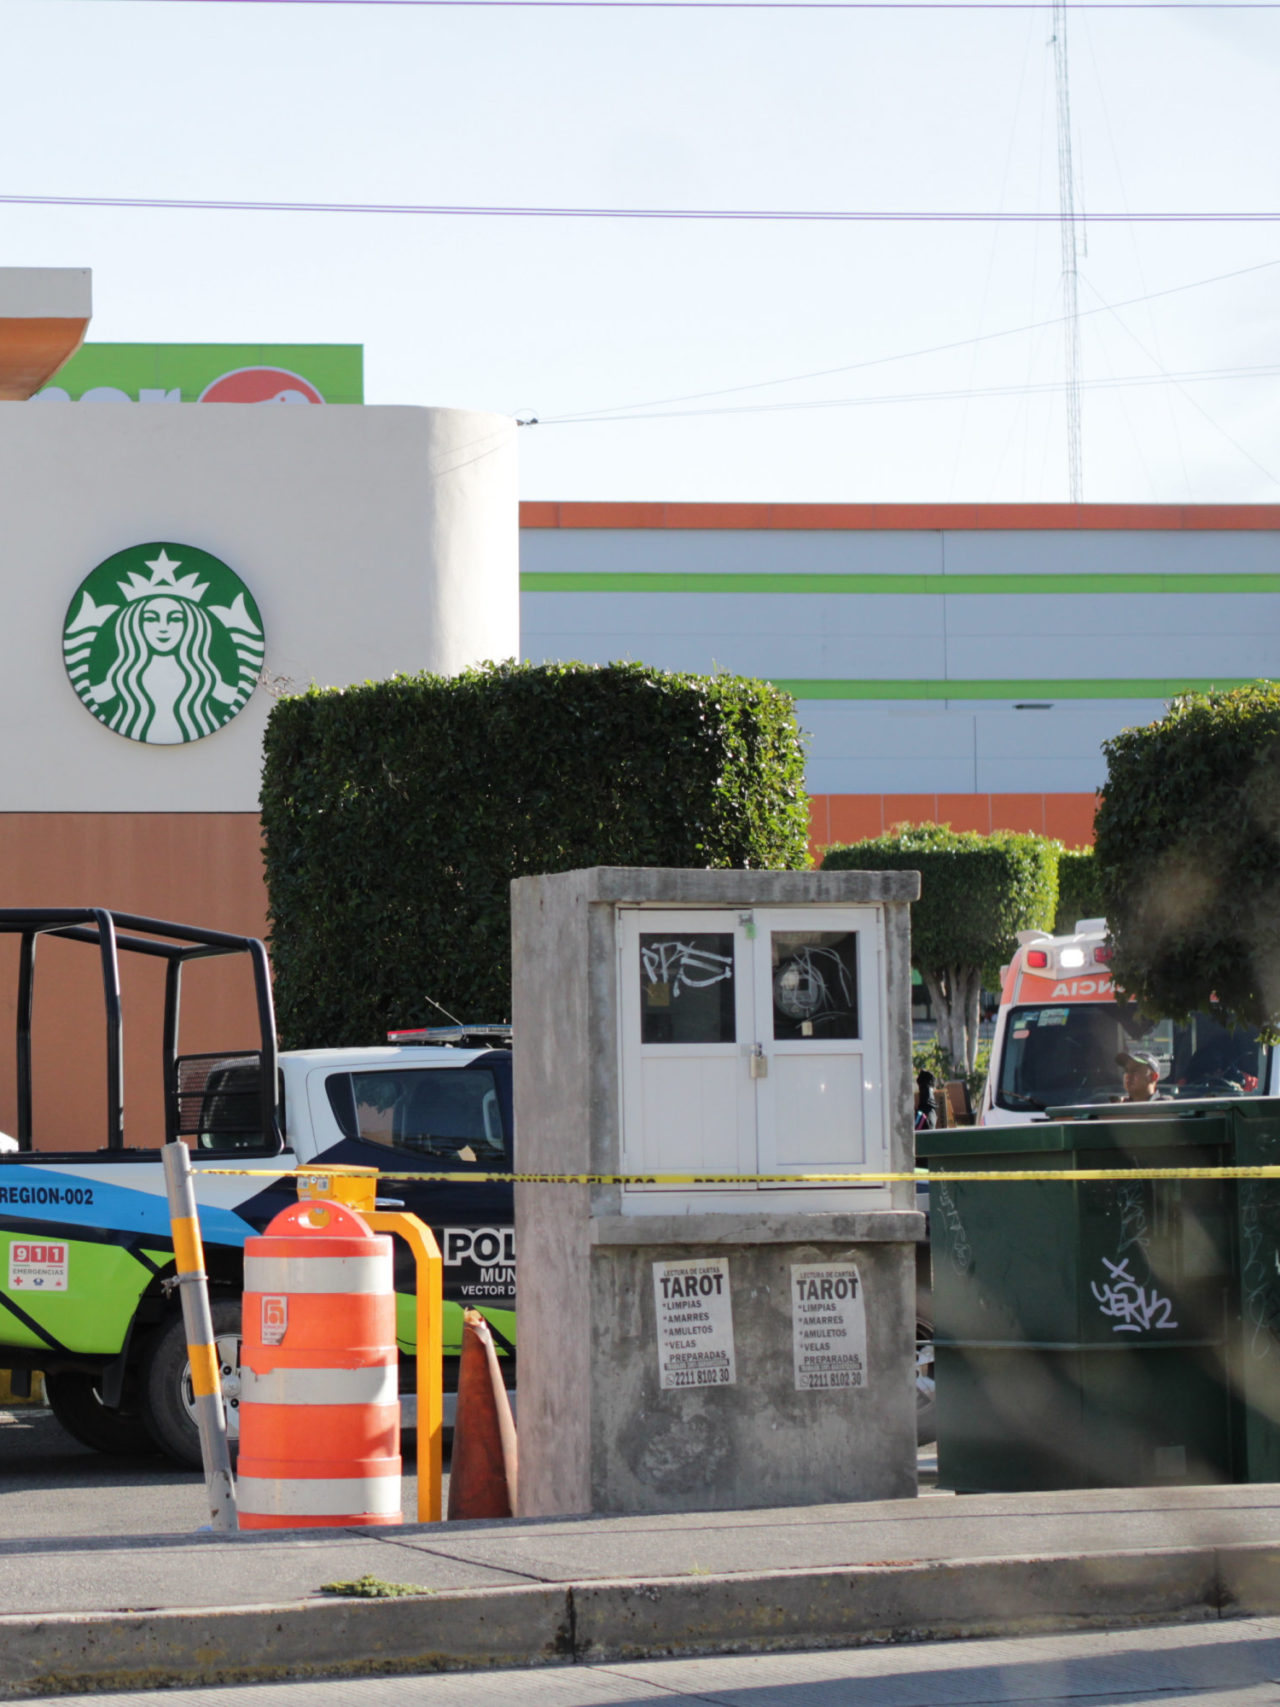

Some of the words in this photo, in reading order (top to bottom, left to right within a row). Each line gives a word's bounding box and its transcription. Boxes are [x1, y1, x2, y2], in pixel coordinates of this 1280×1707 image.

[444, 1227, 517, 1267] POL
[16, 1247, 61, 1261] 911
[12, 1268, 65, 1276] EMERGENCIAS
[461, 1285, 505, 1295] VECTOR
[660, 1274, 723, 1299] TAROT
[796, 1278, 858, 1300] TAROT
[667, 1301, 702, 1310] LIMPIAS
[802, 1303, 836, 1312] LIMPIAS
[668, 1312, 709, 1323] AMARRES
[803, 1316, 843, 1325] AMARRES
[669, 1325, 713, 1336] AMULETOS
[803, 1329, 847, 1338] AMULETOS
[669, 1339, 696, 1349] VELAS
[805, 1343, 831, 1351] VELAS
[669, 1350, 726, 1362] PREPARADAS
[804, 1354, 860, 1364] PREPARADAS
[675, 1371, 695, 1386] 2211
[697, 1369, 717, 1384] 8102
[720, 1367, 730, 1382] 30
[809, 1374, 829, 1388] 2211
[830, 1373, 850, 1387] 8102
[851, 1371, 862, 1386] 30
